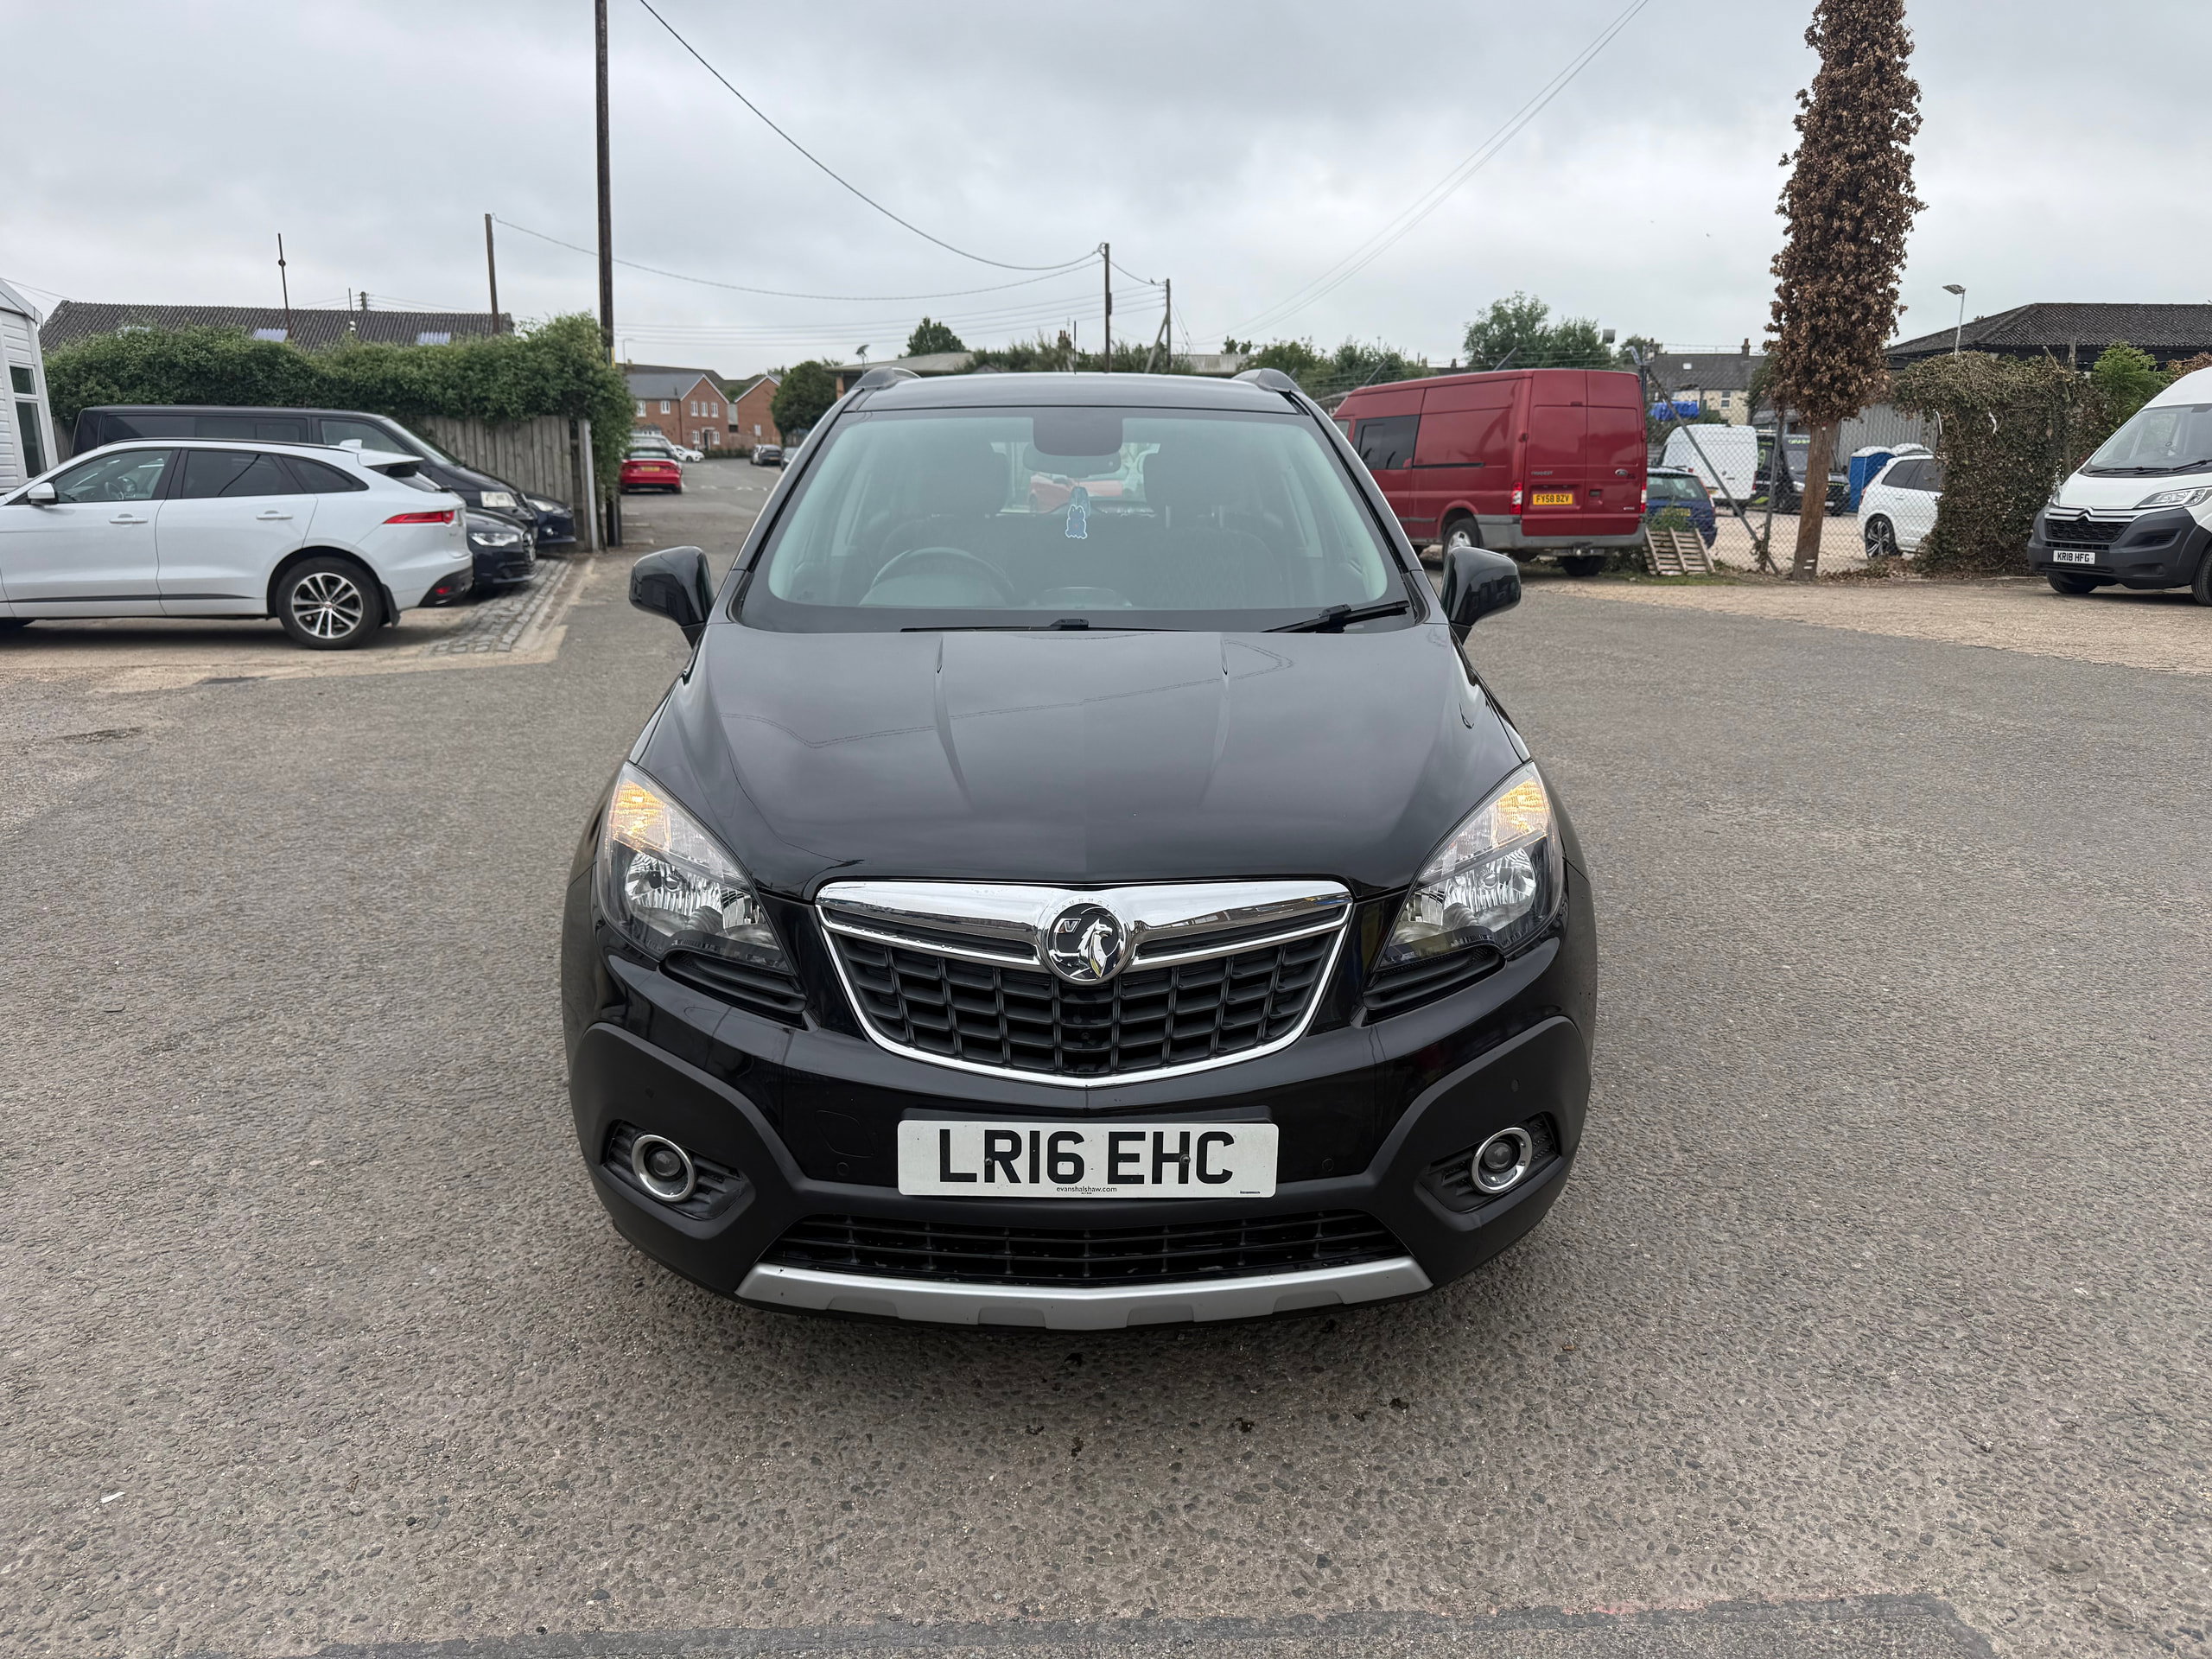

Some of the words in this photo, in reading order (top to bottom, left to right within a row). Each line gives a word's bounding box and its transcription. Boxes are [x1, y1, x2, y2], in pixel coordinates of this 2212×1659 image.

[1535, 494, 1554, 503] FY58
[1556, 494, 1569, 503] BZV
[2057, 552, 2073, 561] KR18
[2075, 553, 2089, 563] HFG
[939, 1128, 1084, 1184] LR16
[1108, 1131, 1234, 1184] EHC
